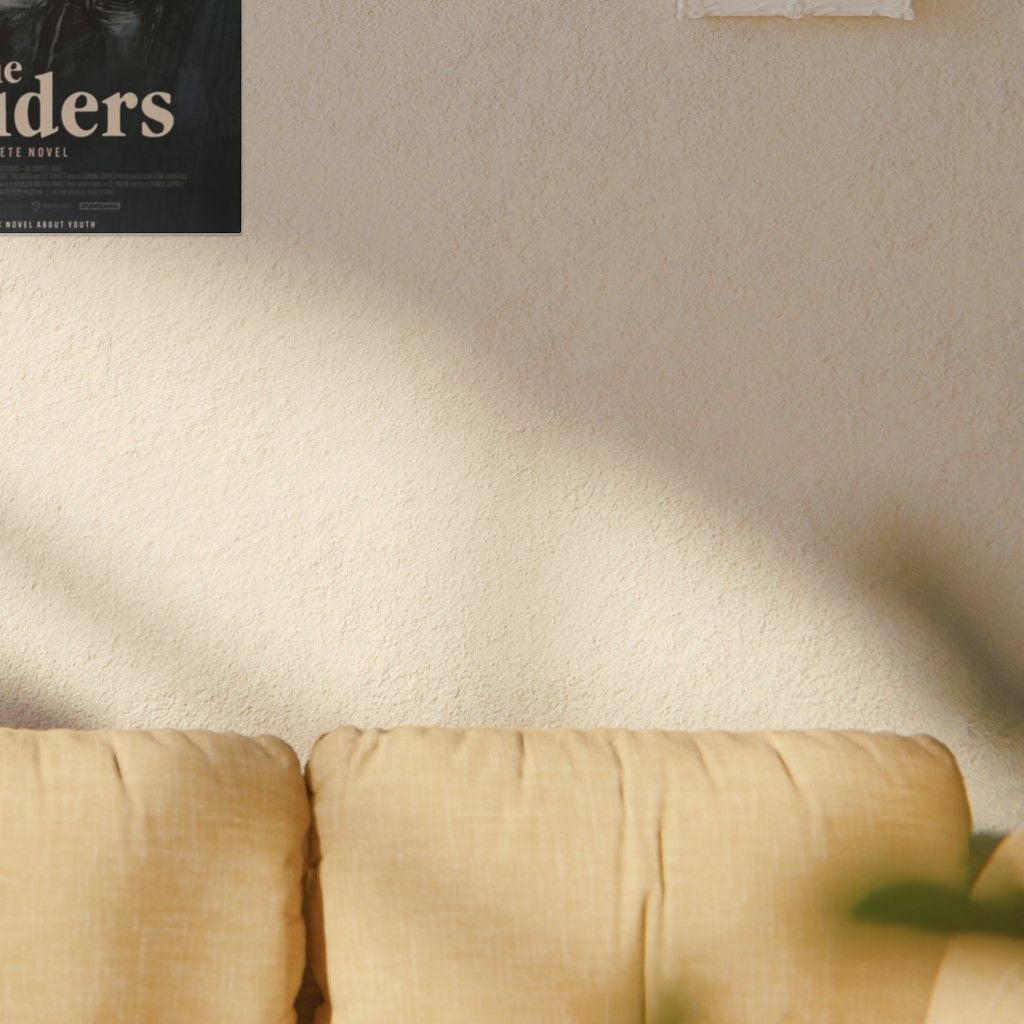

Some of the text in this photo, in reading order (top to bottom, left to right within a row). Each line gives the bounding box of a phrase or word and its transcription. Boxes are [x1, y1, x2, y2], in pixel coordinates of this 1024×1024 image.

[28, 146, 68, 158] NOVEL
[5, 220, 33, 229] NOVEL
[36, 220, 64, 229] ABOUT
[68, 220, 95, 229] YOUTH
